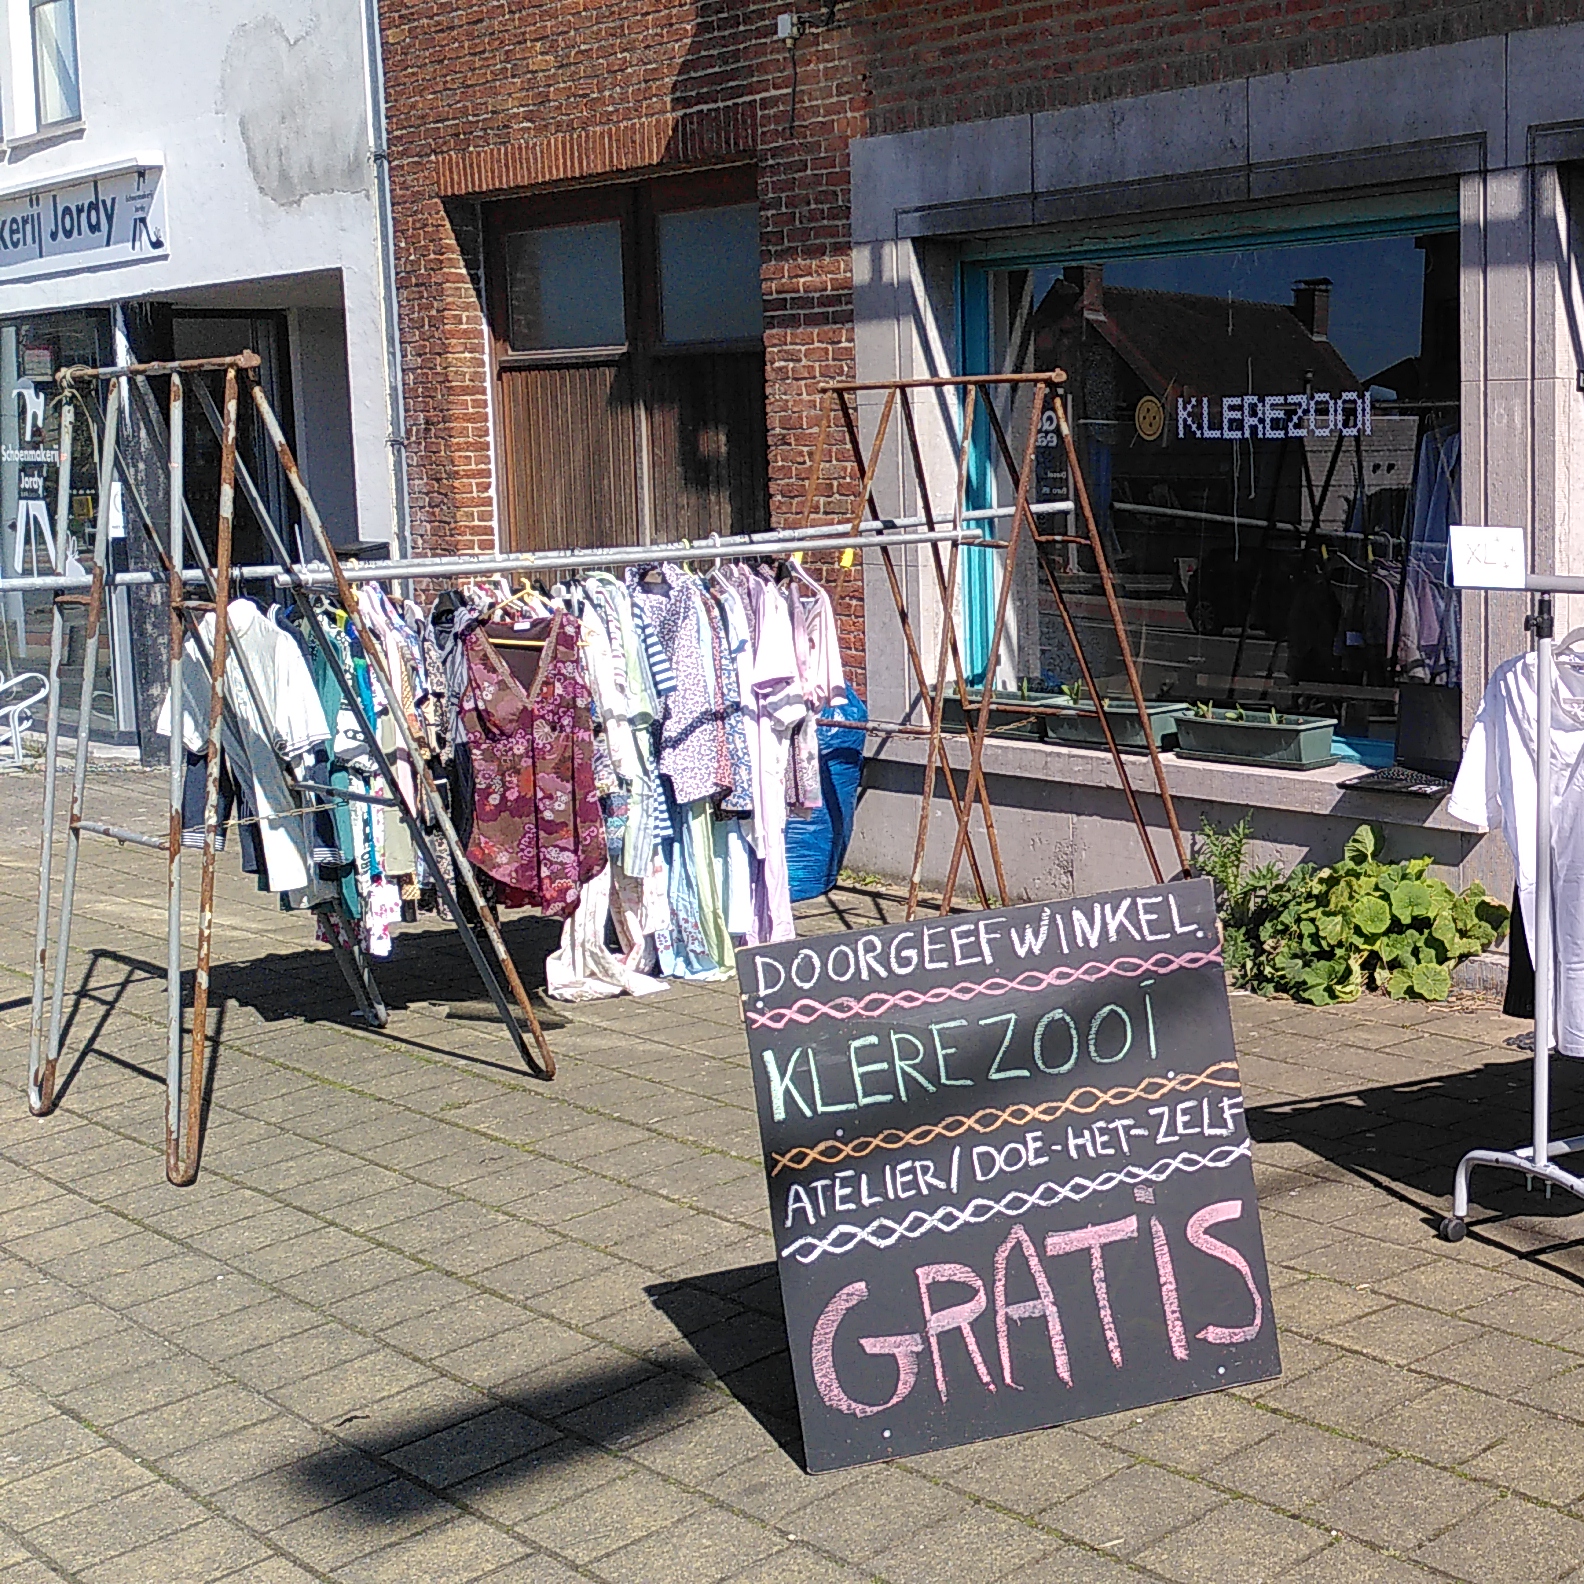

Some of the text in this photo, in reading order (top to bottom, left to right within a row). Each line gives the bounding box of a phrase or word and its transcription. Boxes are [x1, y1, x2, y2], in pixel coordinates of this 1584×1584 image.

[50, 179, 117, 248] Jordy
[1176, 391, 1373, 440] KLEREZOOI
[1, 443, 60, 468] Schoenmakerij
[20, 470, 44, 498] Jordy
